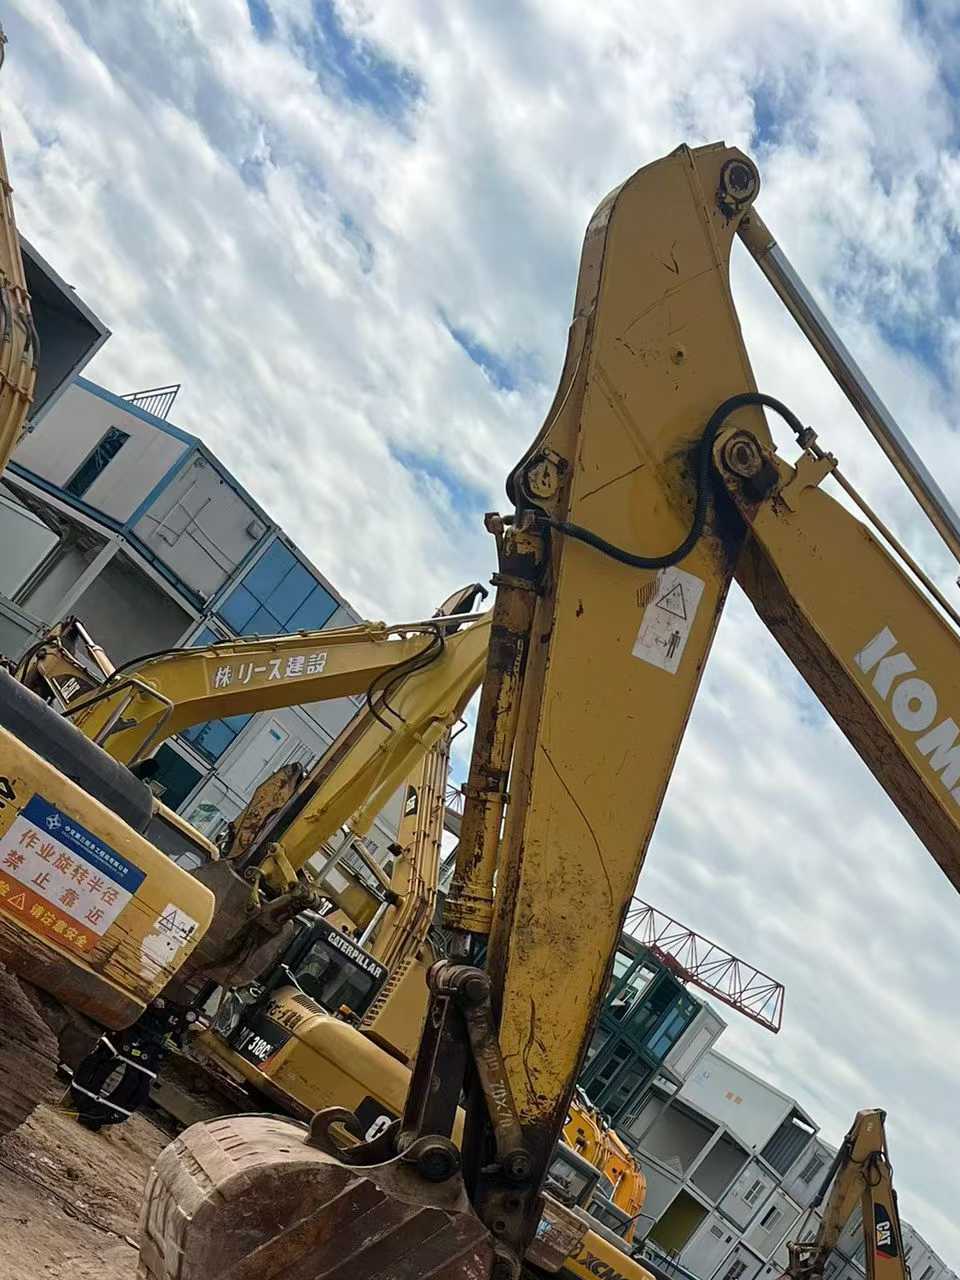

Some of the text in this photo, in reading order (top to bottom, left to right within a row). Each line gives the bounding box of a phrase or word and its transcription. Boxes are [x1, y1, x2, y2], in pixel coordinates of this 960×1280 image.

[20, 830, 119, 906] 作业旋转半径
[328, 932, 381, 978] CATERPILLAR
[876, 1221, 890, 1246] CAT
